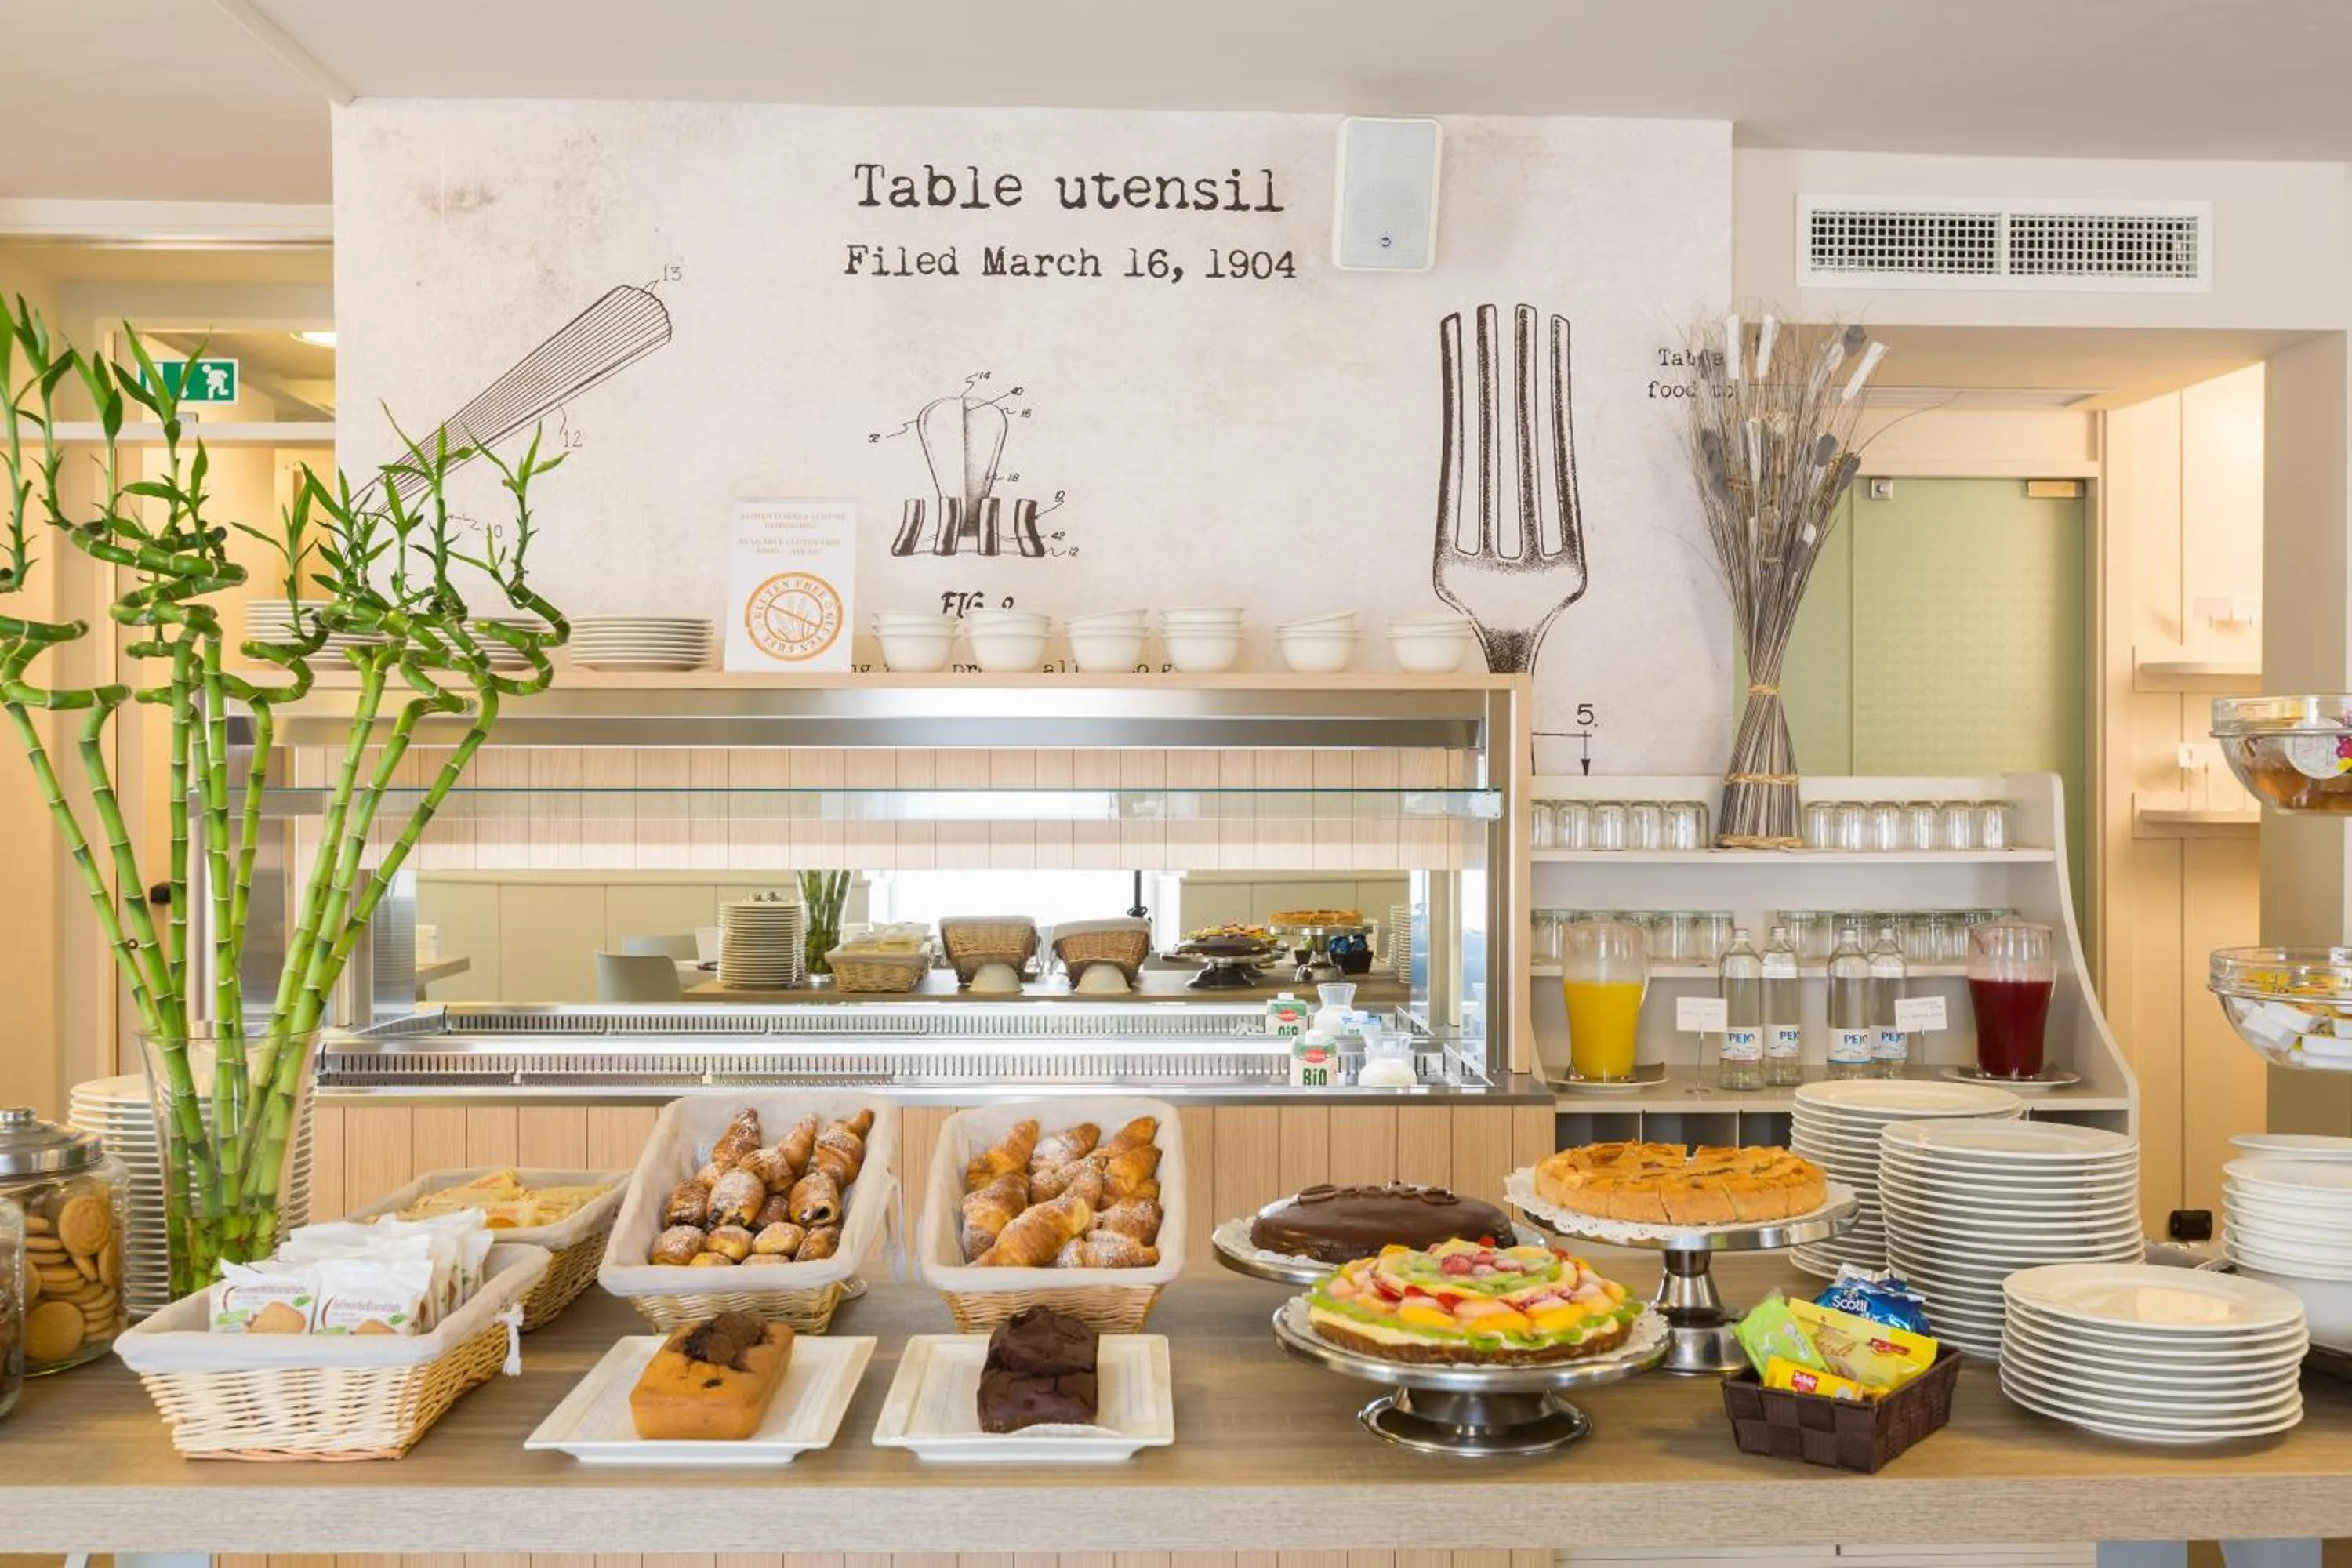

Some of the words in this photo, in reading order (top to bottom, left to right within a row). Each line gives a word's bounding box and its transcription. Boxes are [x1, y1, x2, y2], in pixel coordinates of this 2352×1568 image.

[854, 163, 1023, 209] Table
[1054, 168, 1286, 212] utensil
[663, 265, 682, 282] 13
[844, 245, 960, 278] Filed
[982, 246, 1102, 278] March
[1123, 248, 1185, 284] 16,
[1205, 249, 1298, 280] 1904
[562, 430, 583, 448] 12
[1832, 1294, 1868, 1312] Scotti
